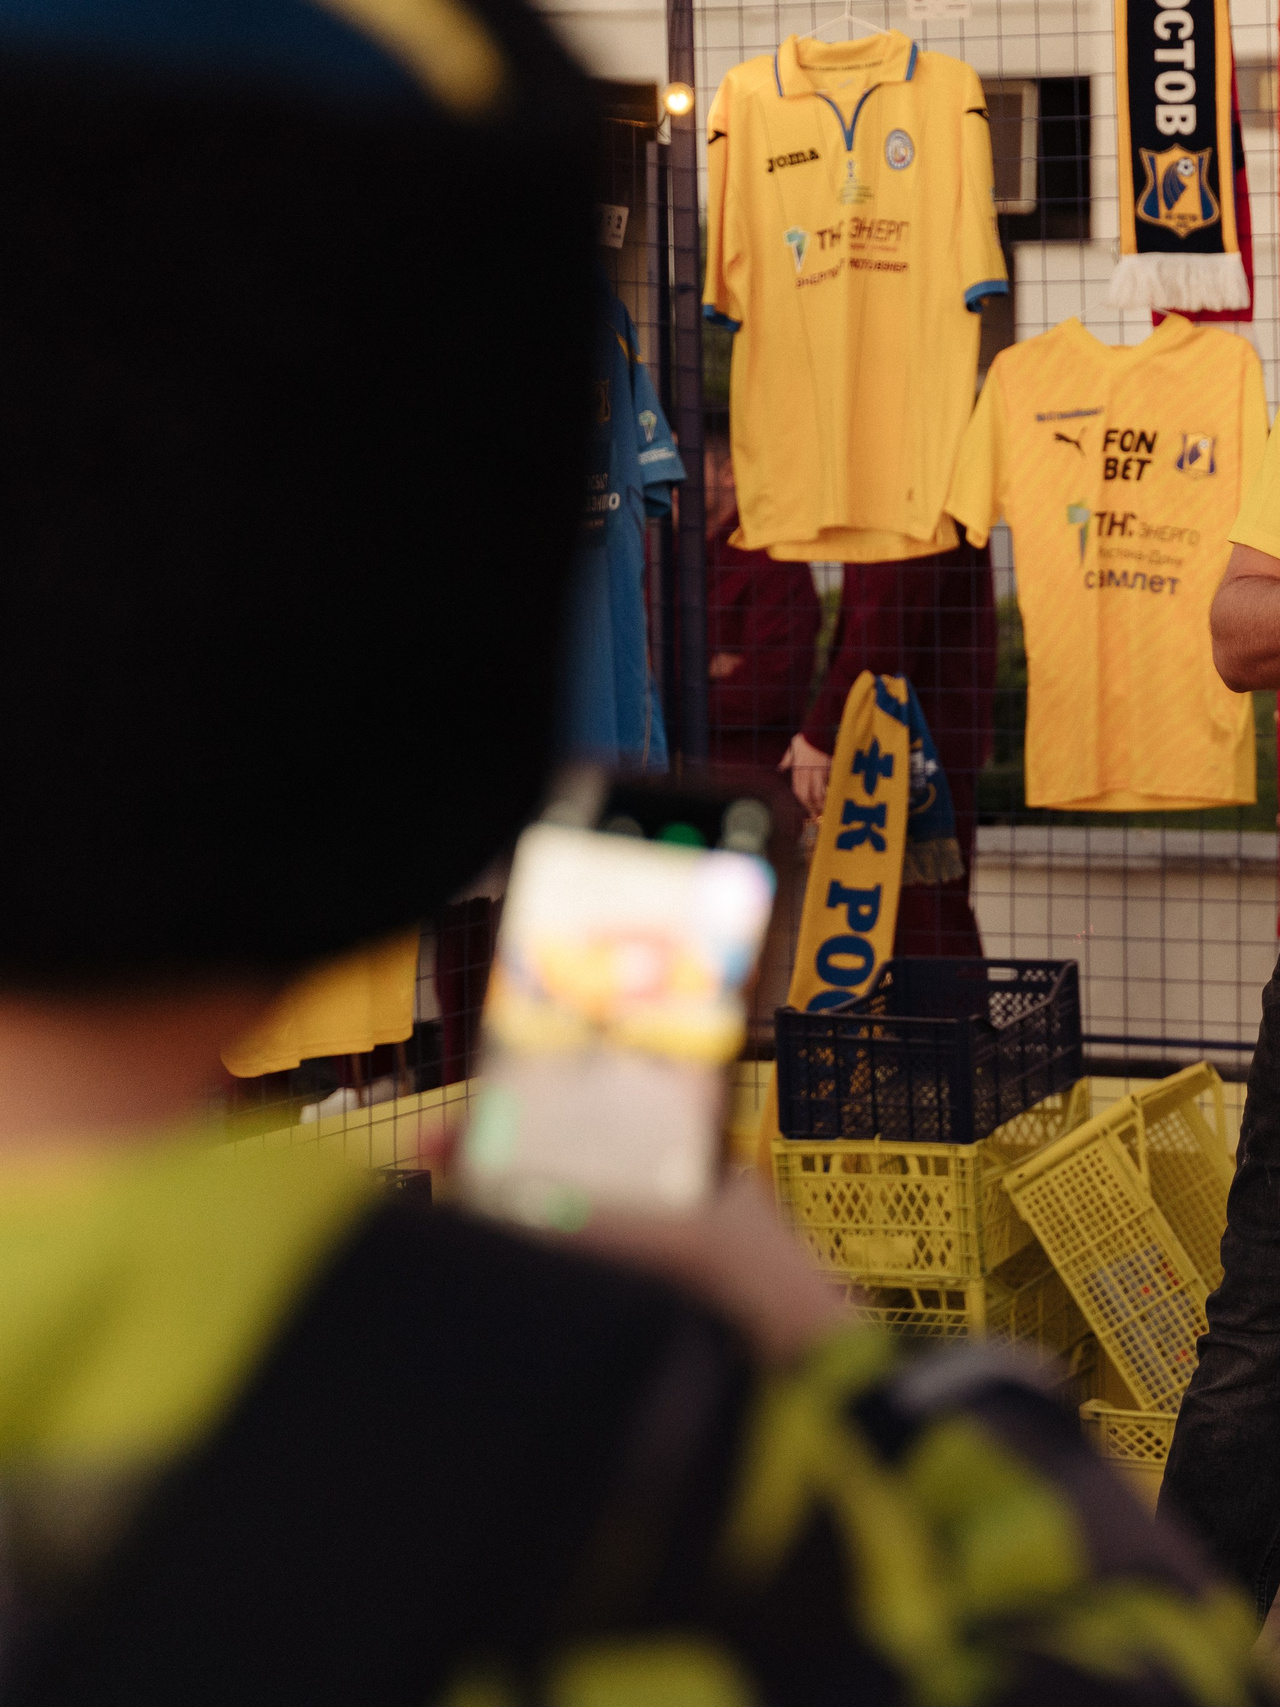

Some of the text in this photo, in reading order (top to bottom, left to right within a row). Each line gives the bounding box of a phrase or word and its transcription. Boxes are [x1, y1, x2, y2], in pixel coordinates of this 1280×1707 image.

[1153, 0, 1197, 136] СТОВ
[1102, 428, 1158, 454] FON
[1104, 457, 1153, 481] BET
